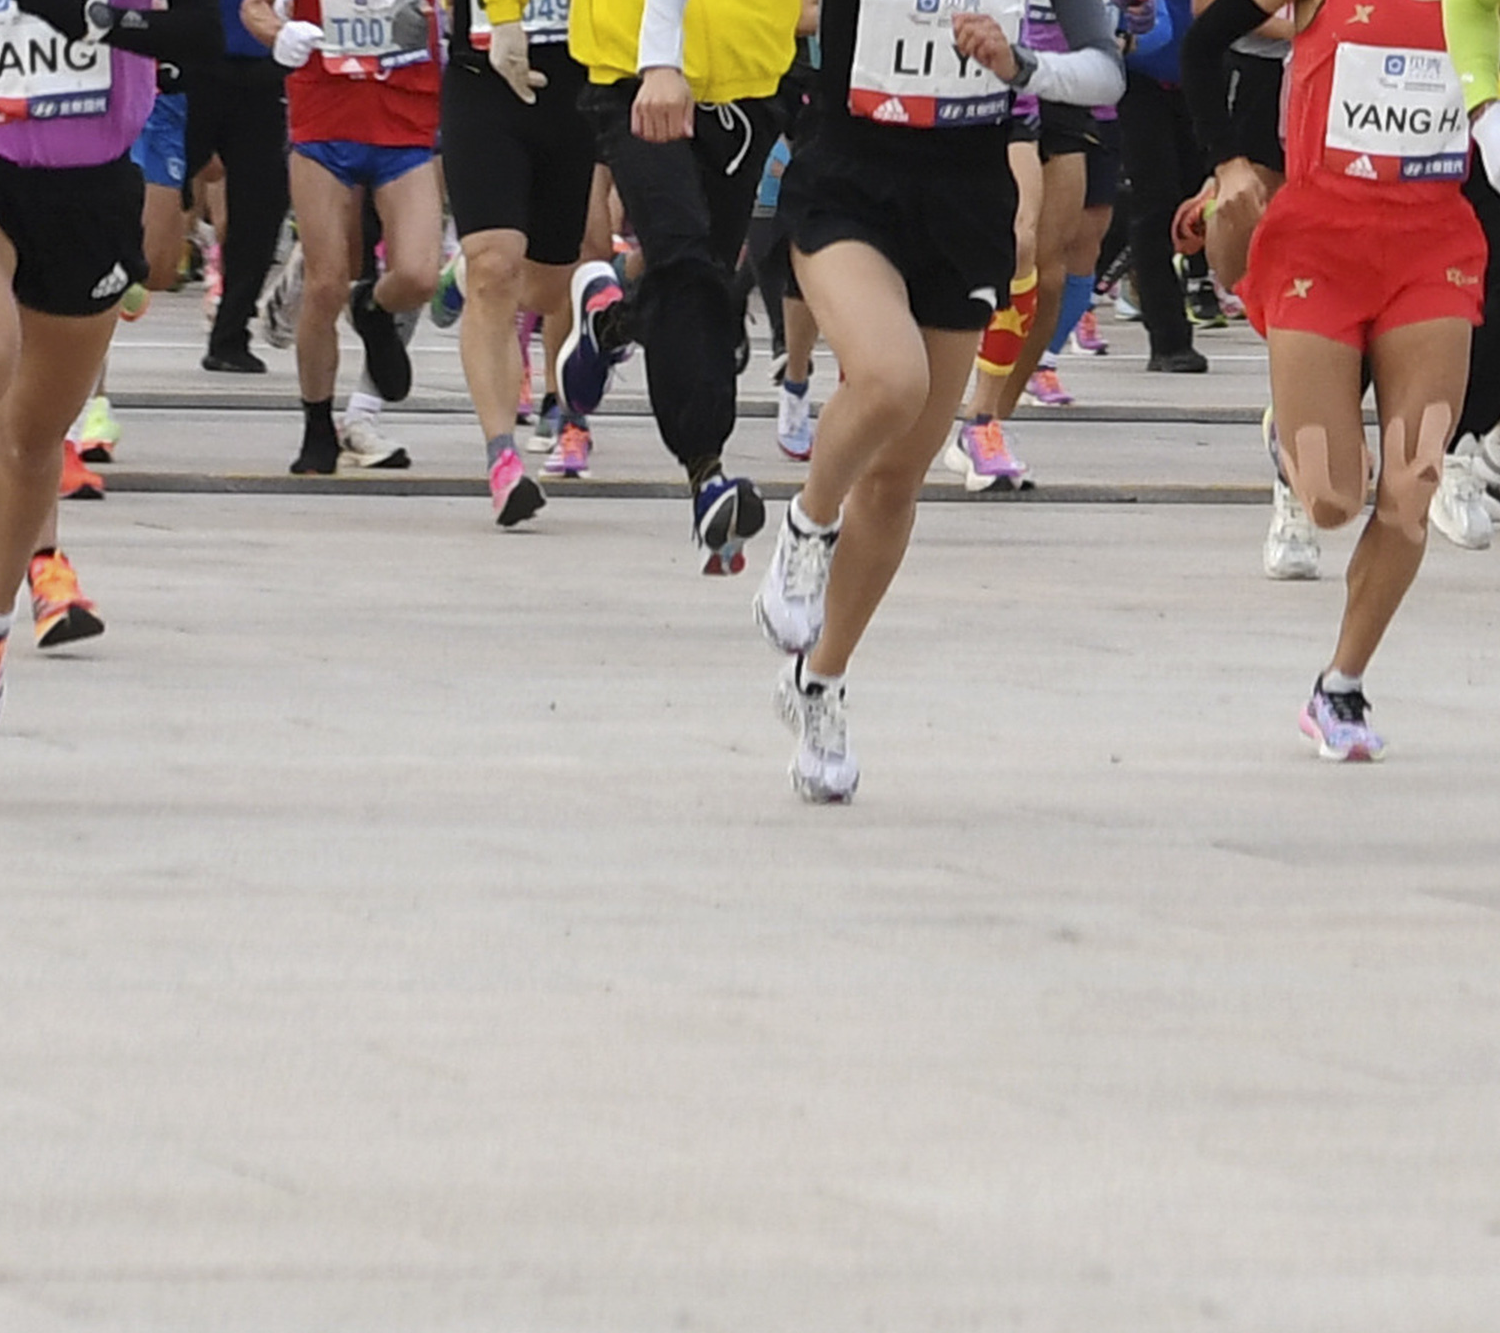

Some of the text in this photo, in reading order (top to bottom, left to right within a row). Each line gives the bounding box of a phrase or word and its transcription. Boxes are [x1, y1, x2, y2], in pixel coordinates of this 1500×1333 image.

[331, 16, 393, 47] T00
[893, 38, 935, 76] LI
[1342, 100, 1462, 135] YANG H.
